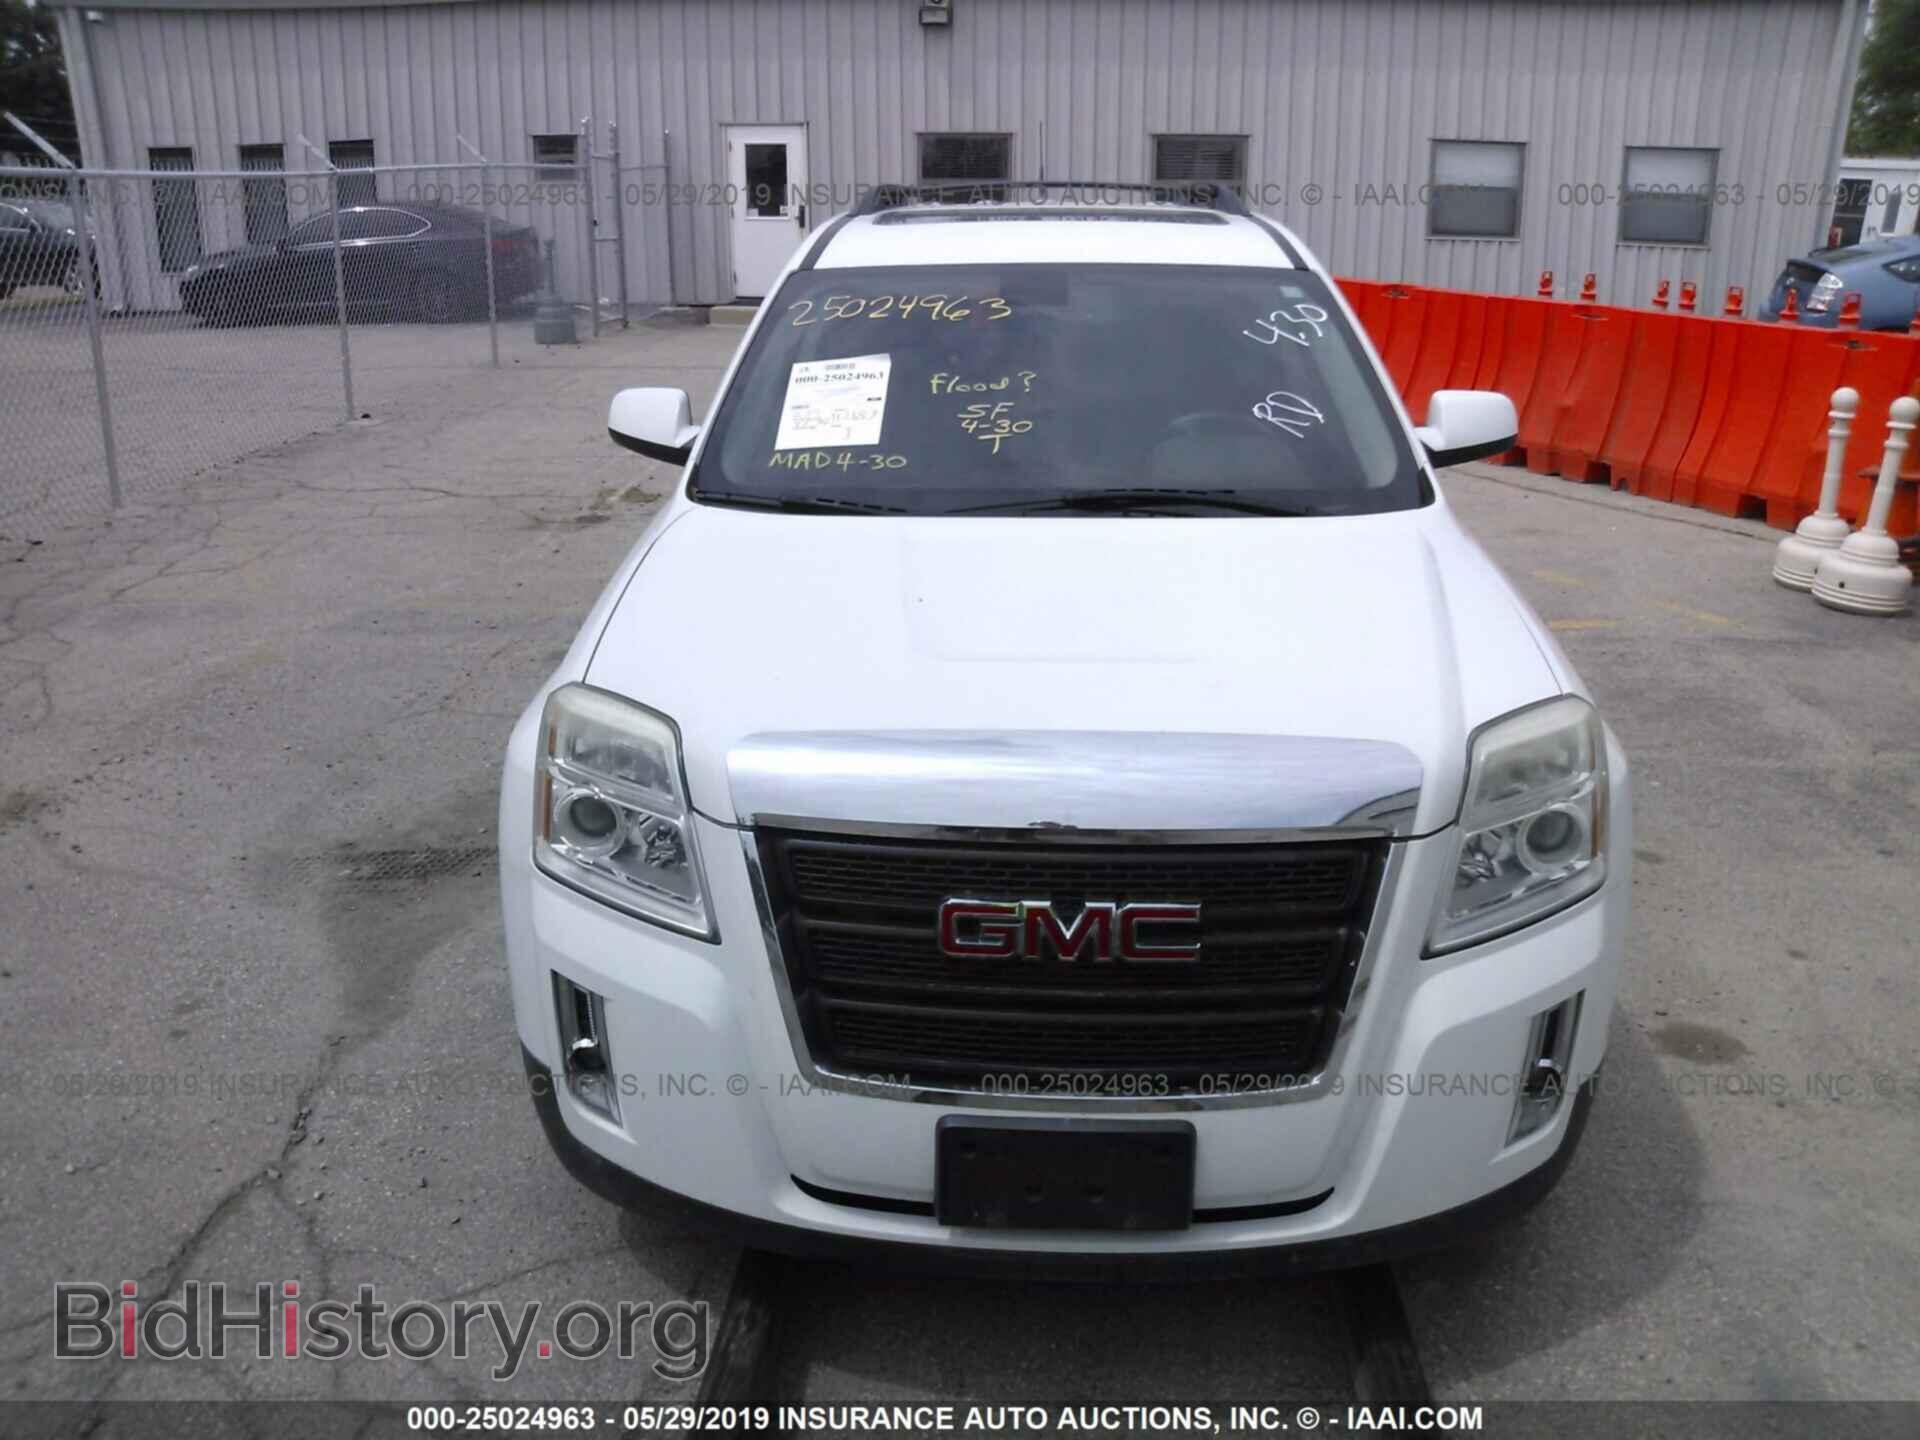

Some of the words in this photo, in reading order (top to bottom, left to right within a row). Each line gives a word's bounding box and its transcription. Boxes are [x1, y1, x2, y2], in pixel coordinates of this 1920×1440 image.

[788, 295, 1012, 326] 25024963
[961, 417, 1033, 434] 4-30
[940, 898, 1201, 961] GMC
